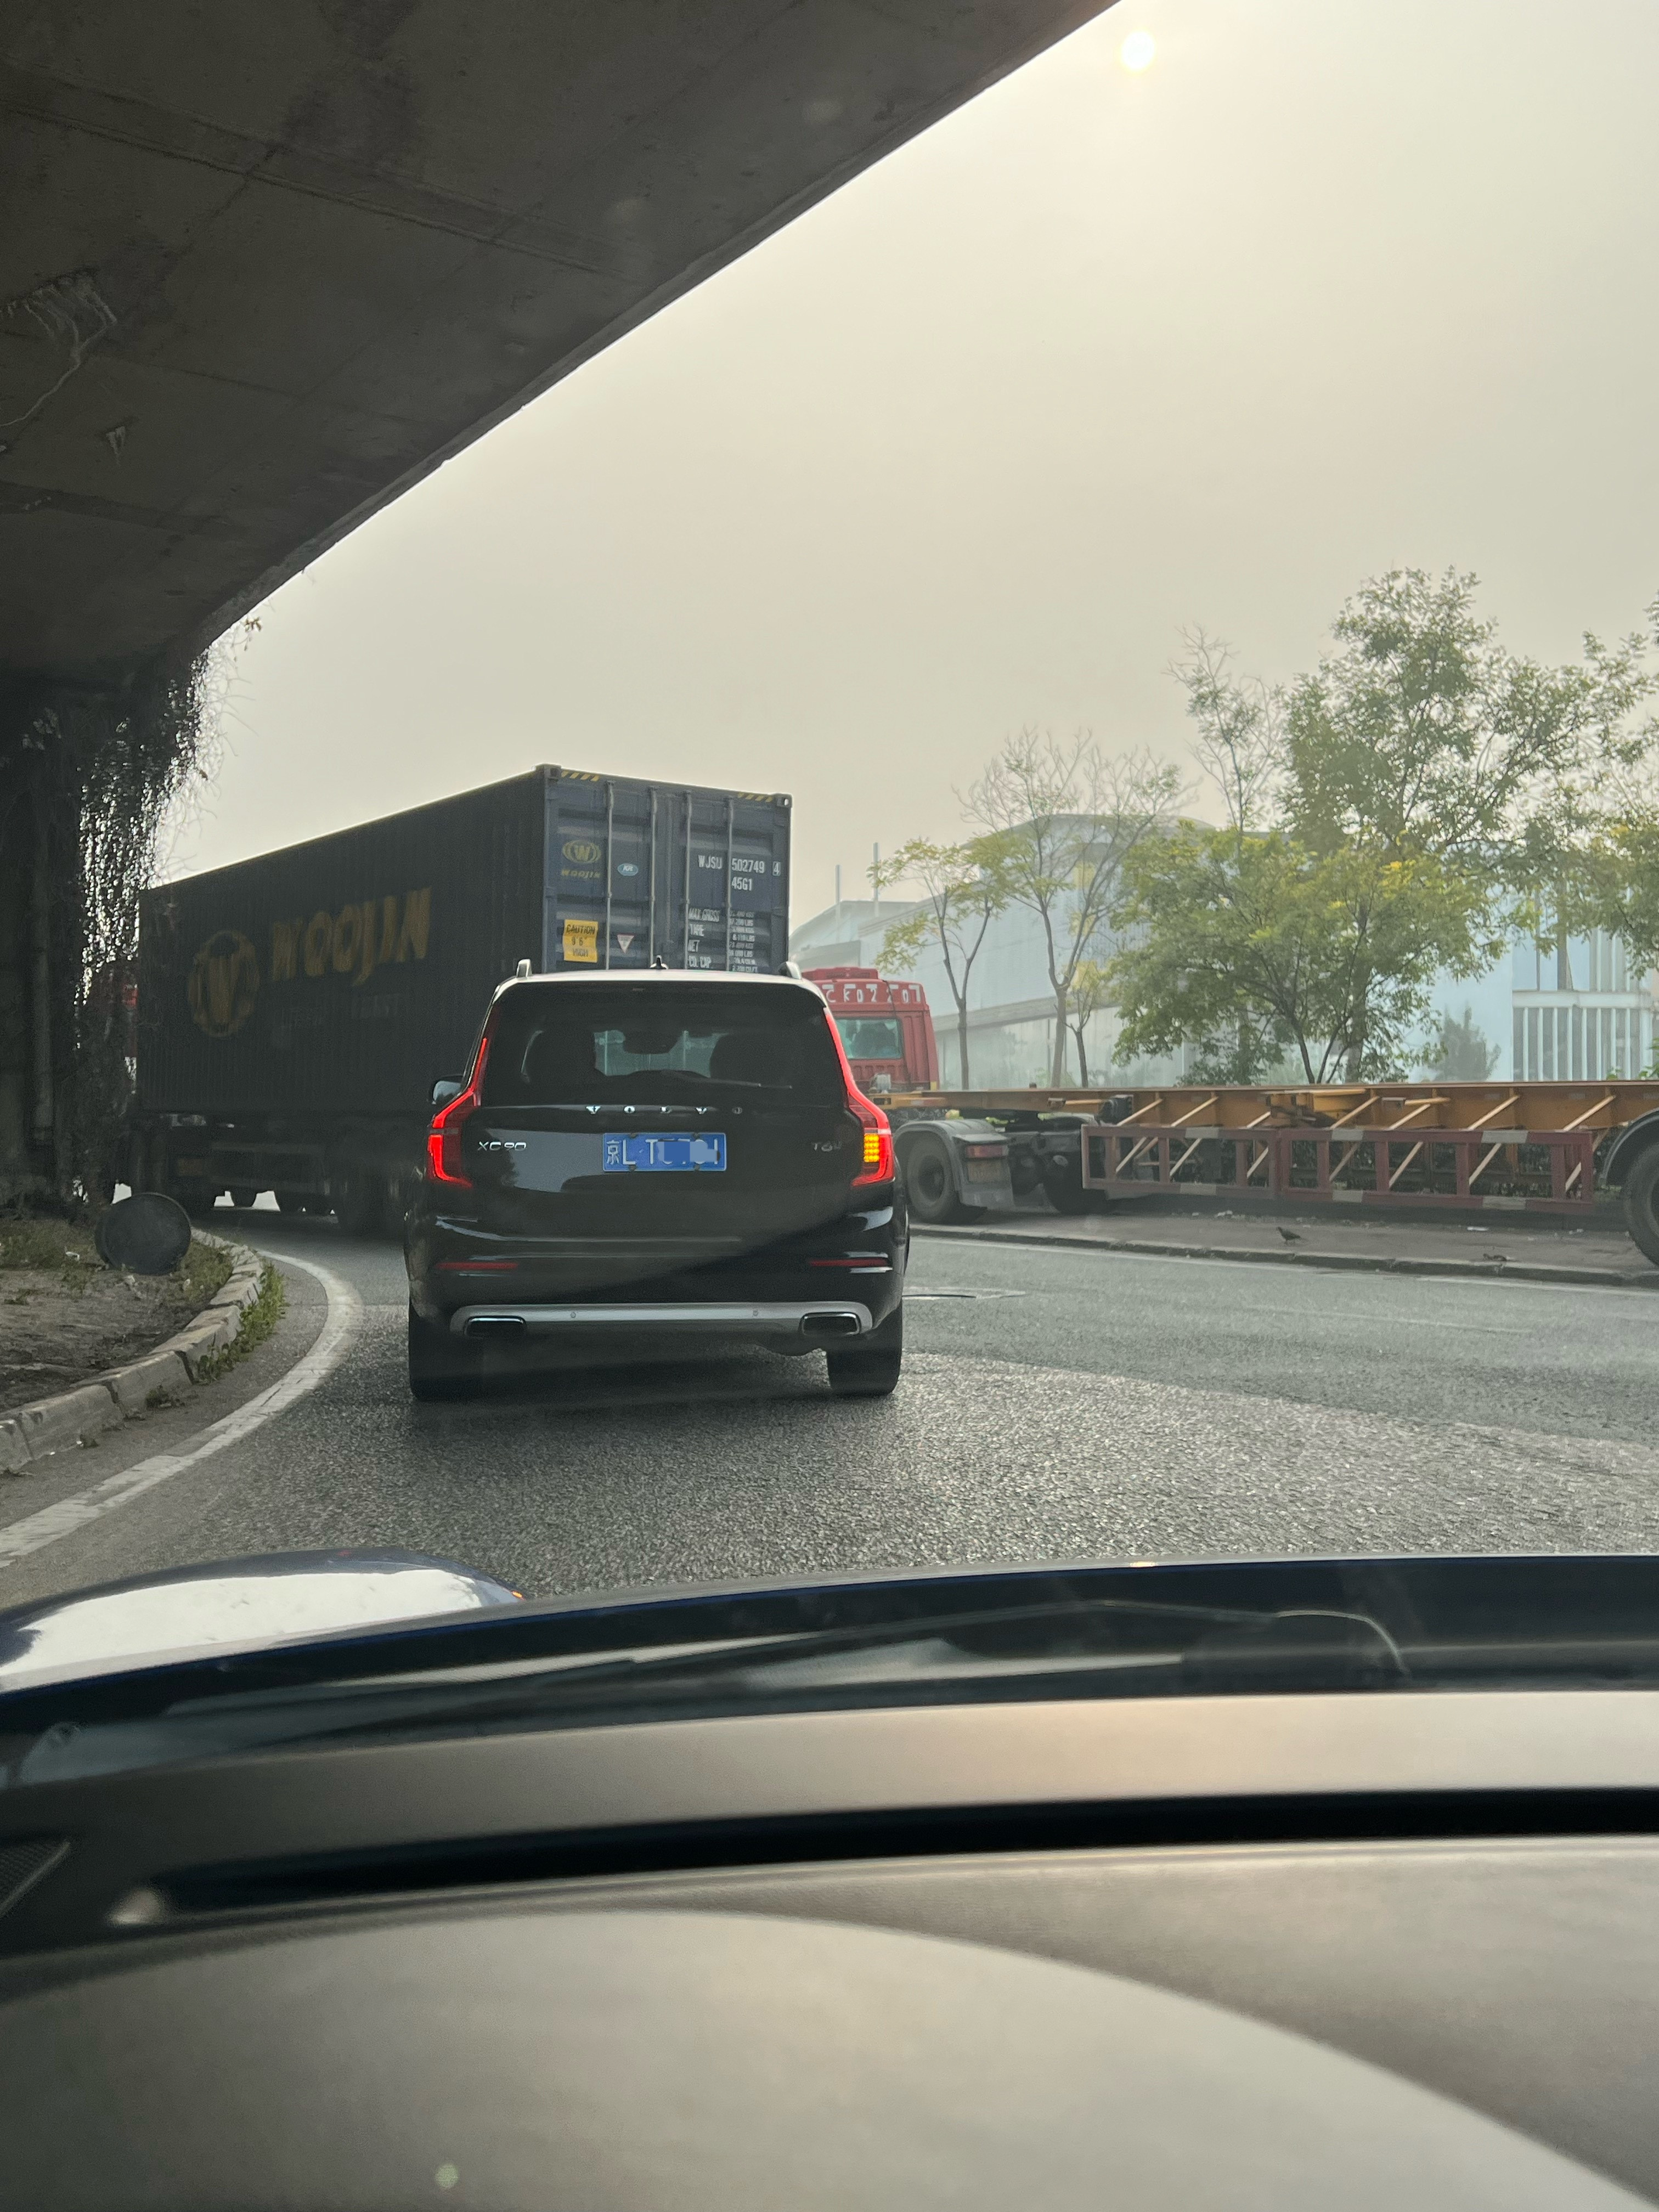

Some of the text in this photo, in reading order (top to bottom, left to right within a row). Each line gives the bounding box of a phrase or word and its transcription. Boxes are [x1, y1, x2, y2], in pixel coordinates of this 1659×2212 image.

[698, 855, 780, 876] WJSU 502749 4
[731, 877, 752, 891] 45G1
[566, 924, 596, 934] CAUTION
[272, 887, 432, 986] WOOJIN
[586, 1105, 742, 1114] VOLVO
